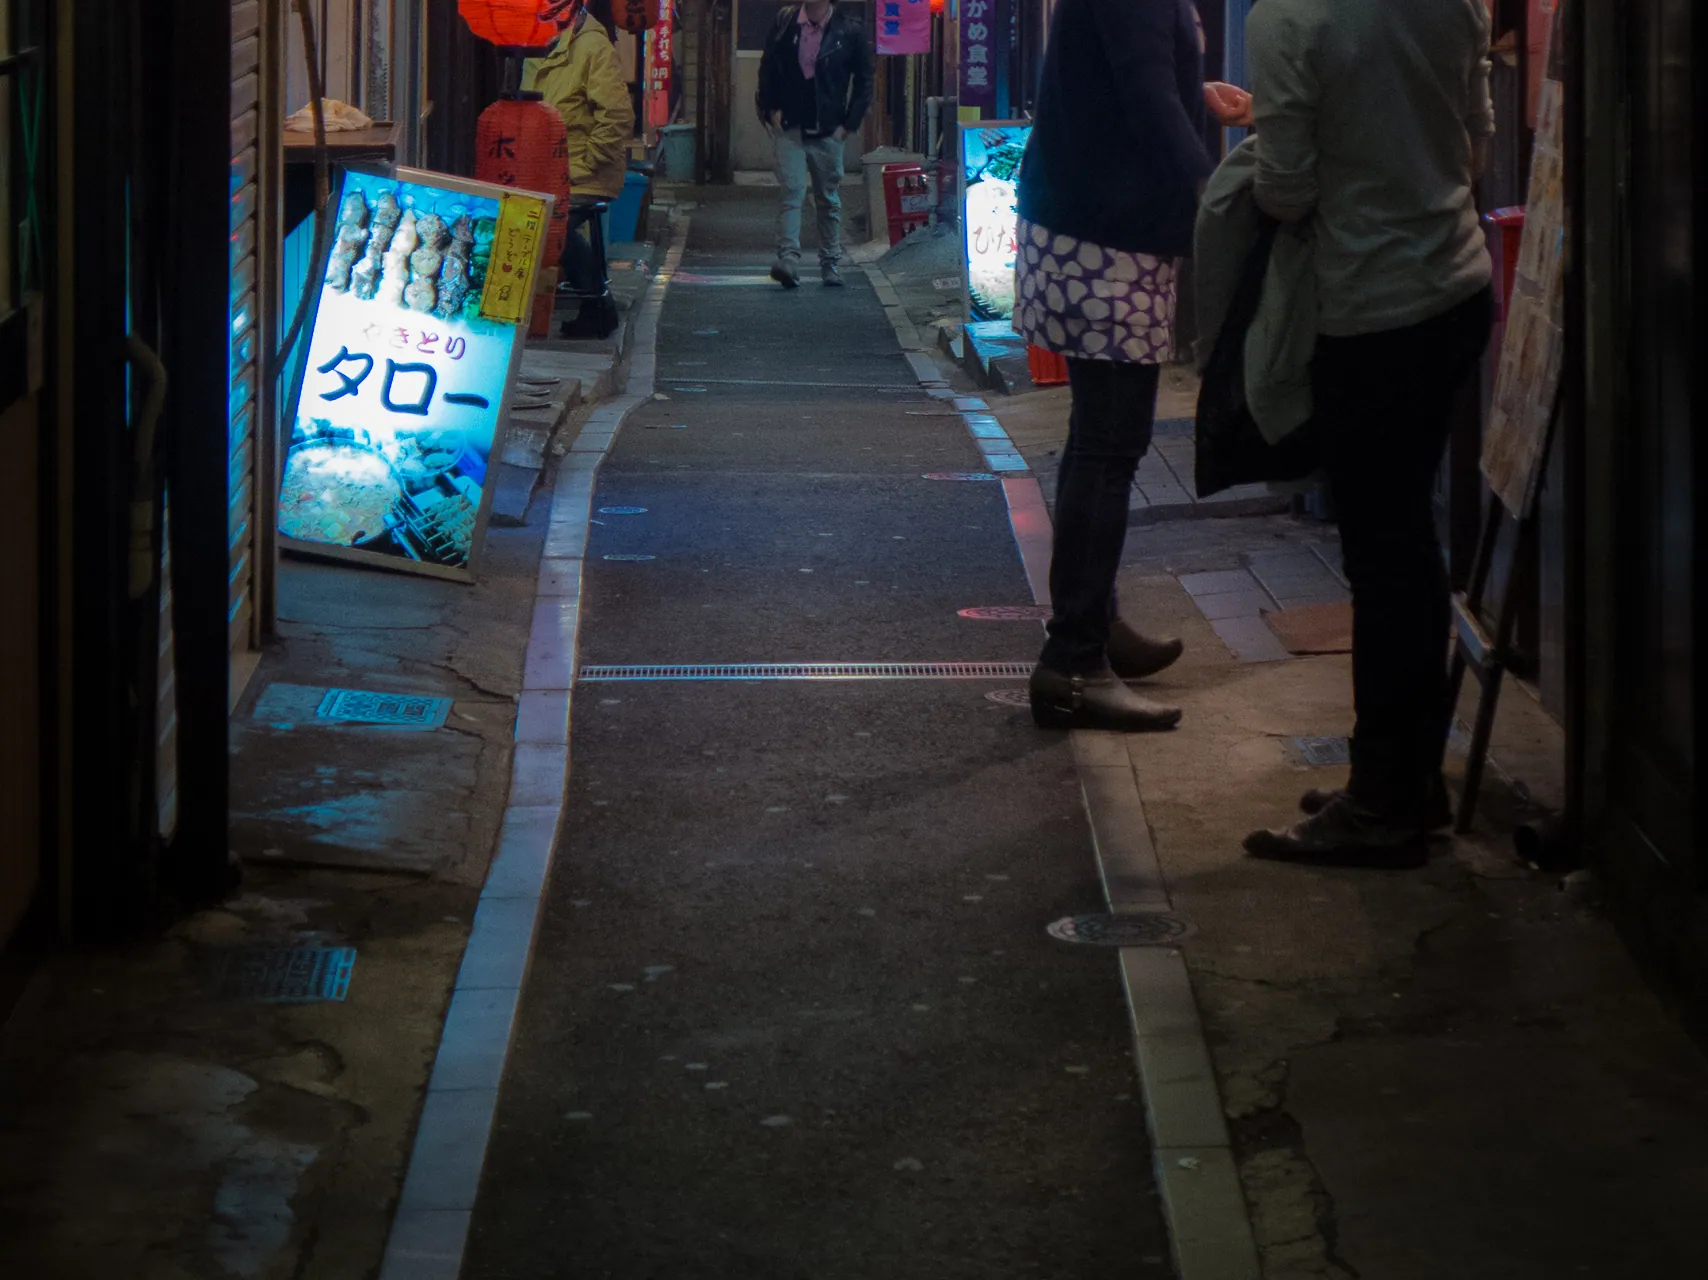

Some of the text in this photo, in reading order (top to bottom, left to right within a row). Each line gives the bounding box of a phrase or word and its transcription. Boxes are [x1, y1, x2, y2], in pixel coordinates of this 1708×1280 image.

[363, 322, 467, 361] やきとり
[316, 345, 490, 417] タロー
